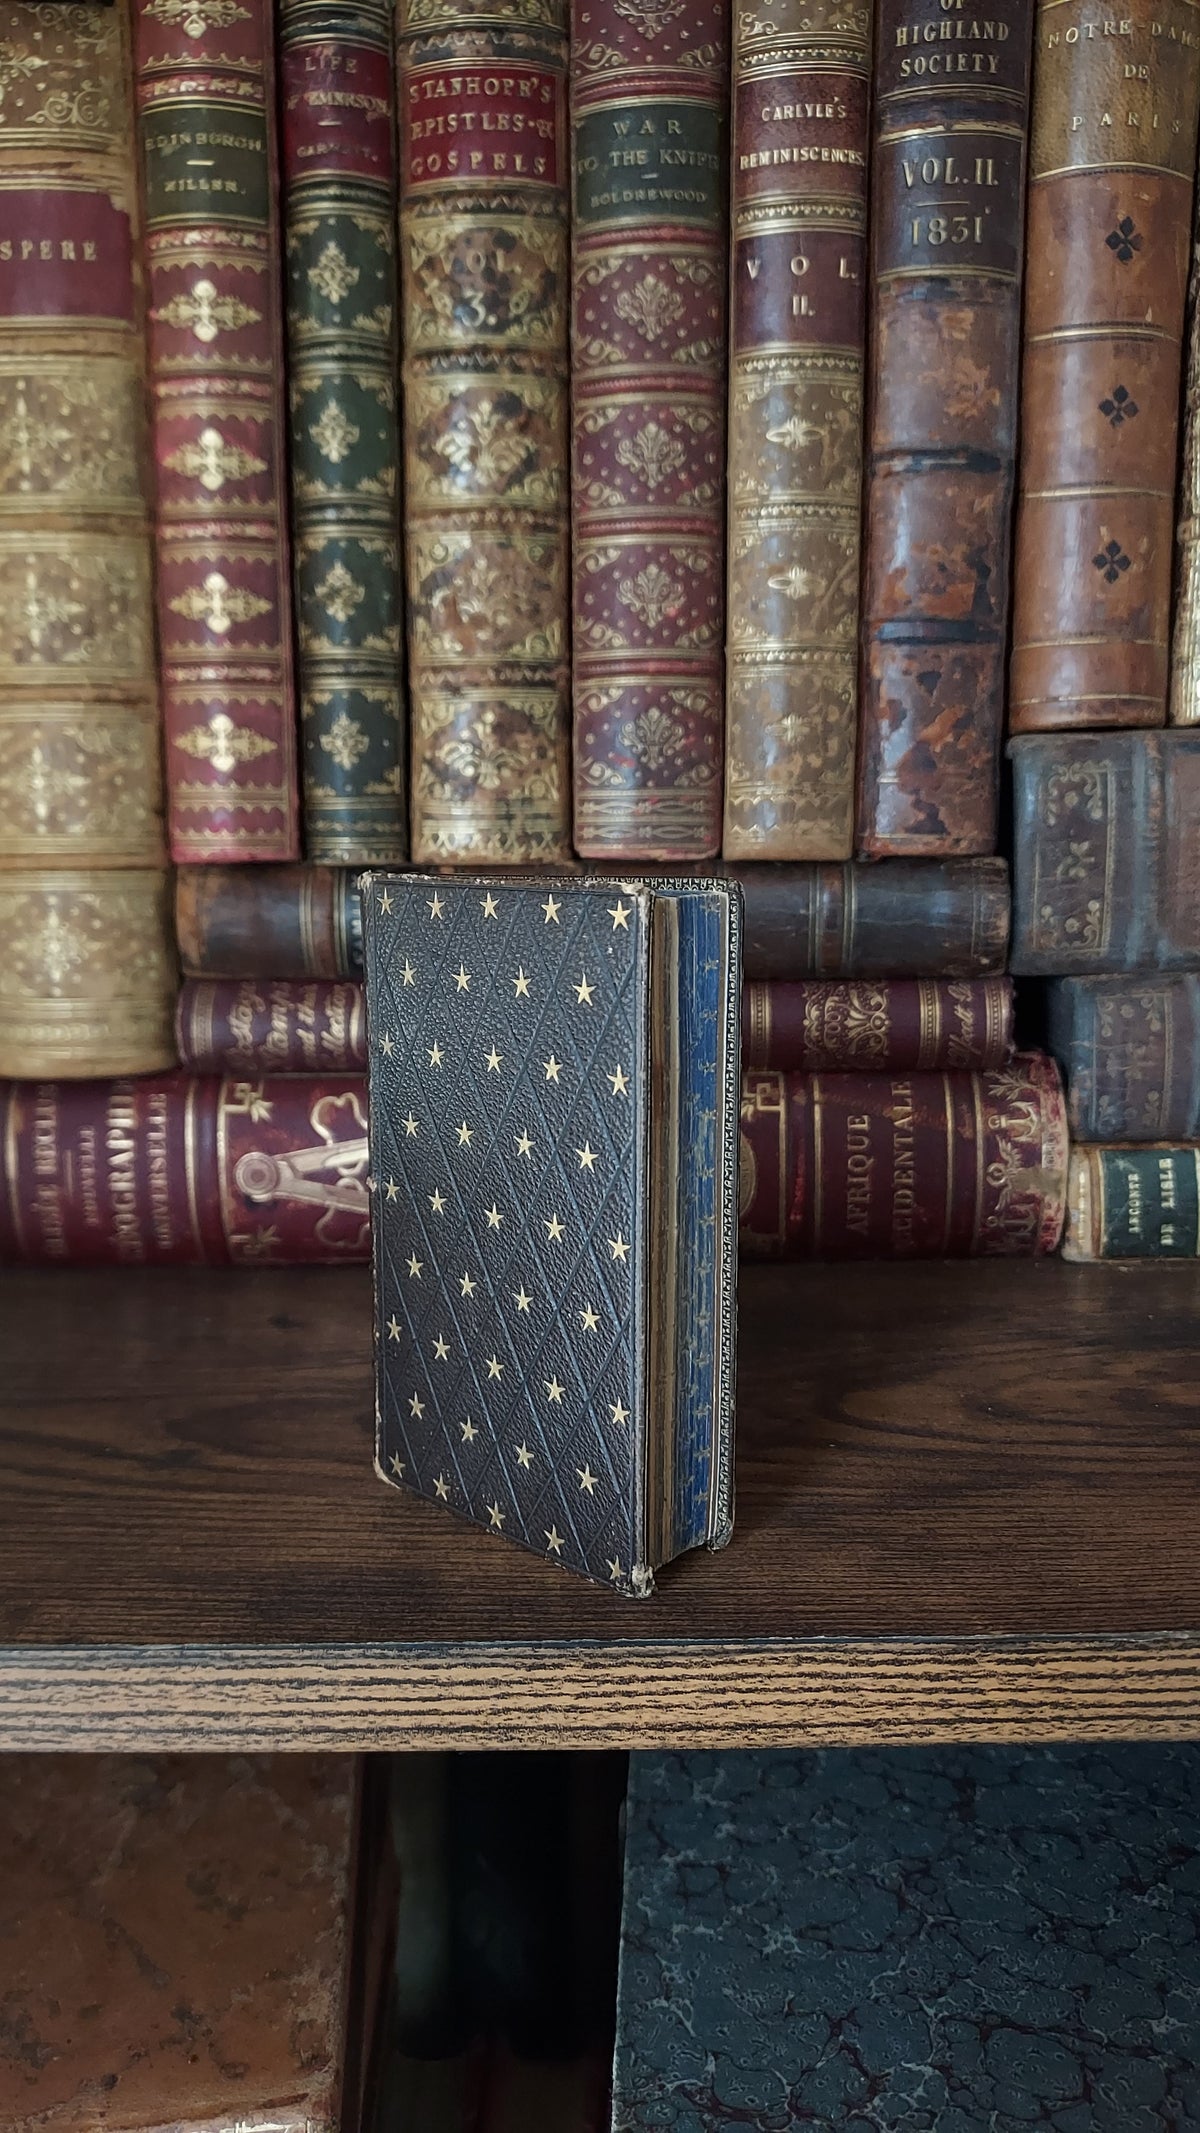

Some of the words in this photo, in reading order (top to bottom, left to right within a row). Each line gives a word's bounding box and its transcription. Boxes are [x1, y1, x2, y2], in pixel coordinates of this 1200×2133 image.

[895, 20, 1009, 47] HIGHLAND
[304, 56, 358, 74] LIFE
[900, 53, 1000, 77] SOCIETY
[1124, 64, 1149, 79] DE
[409, 76, 552, 104] STANHOPE'S
[761, 96, 848, 122] CARLYLE'S
[613, 119, 683, 135] WAR
[1071, 112, 1182, 134] PARIS
[410, 150, 547, 176] GOSPELS
[608, 149, 649, 168] THE
[659, 149, 720, 170] KNIFE
[902, 157, 969, 188] VOL.
[911, 216, 983, 246] 1831
[0, 239, 97, 261] SPERE
[746, 255, 858, 280] VOL.
[846, 1114, 875, 1236] AFRIQUE
[891, 1078, 915, 1248] CIDENTALE
[1159, 1158, 1176, 1209] LISLE
